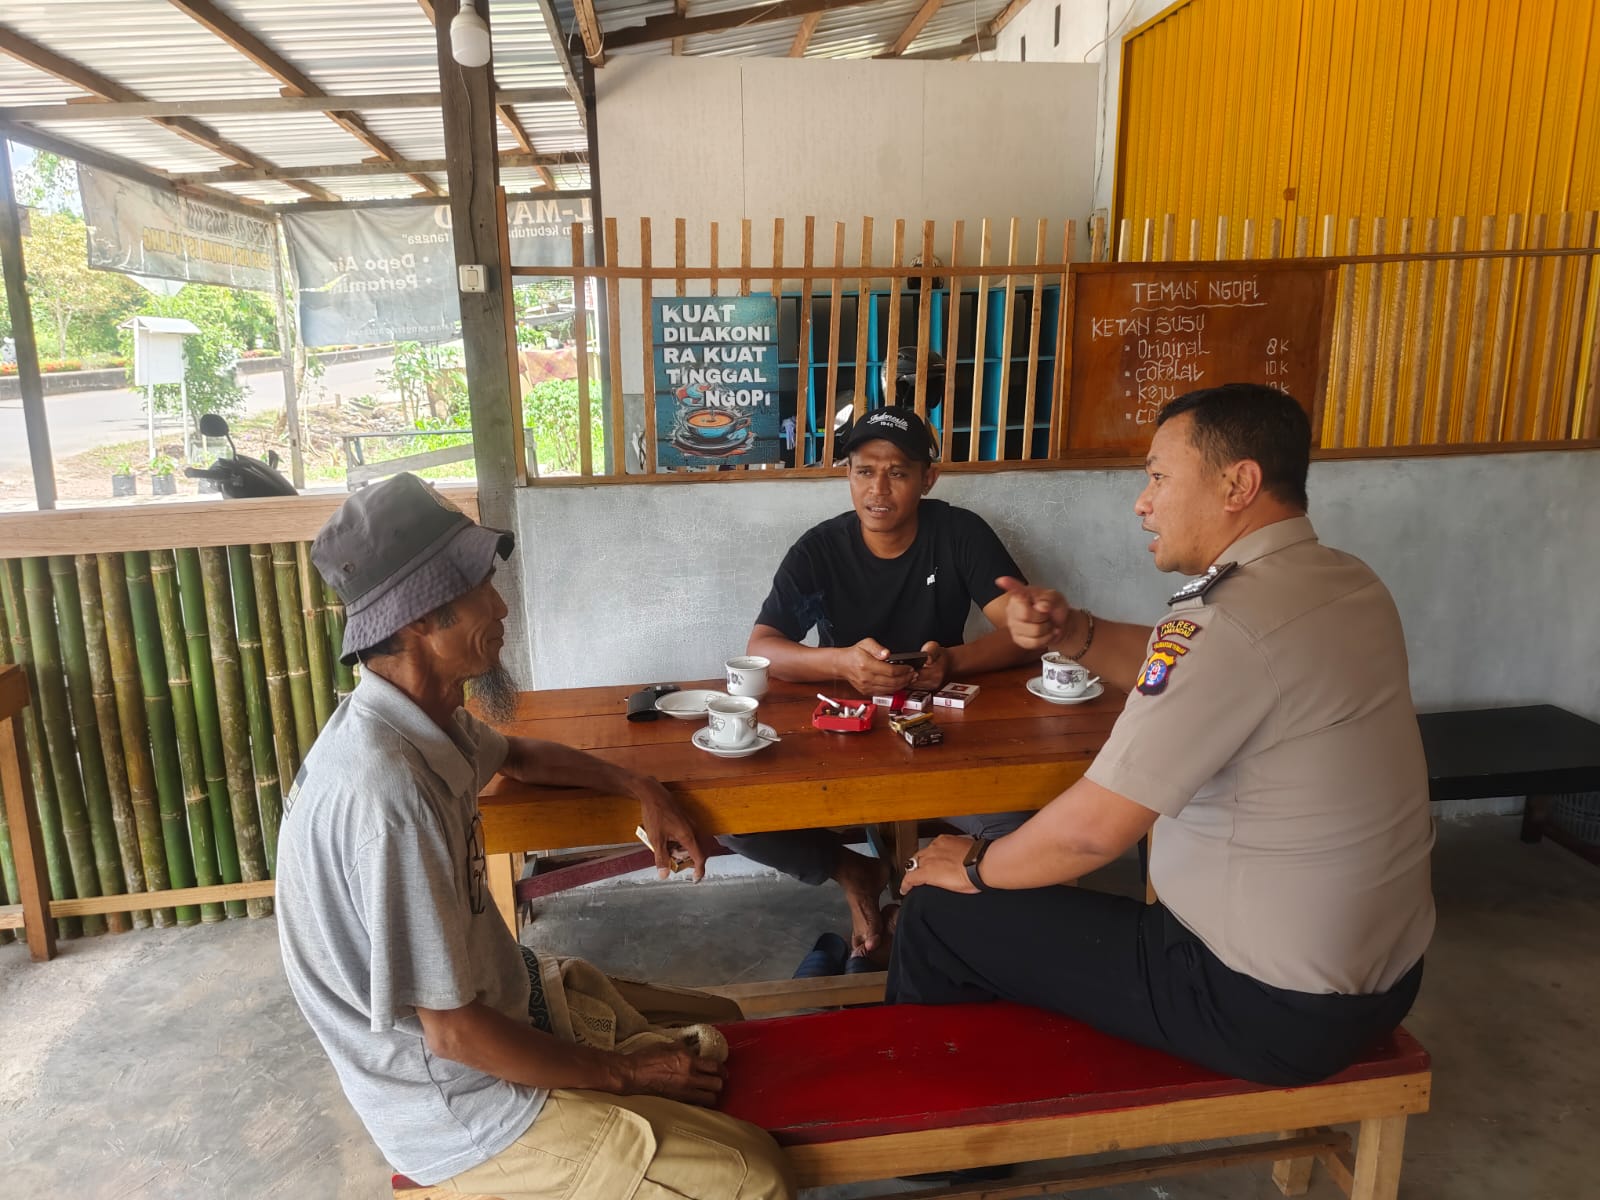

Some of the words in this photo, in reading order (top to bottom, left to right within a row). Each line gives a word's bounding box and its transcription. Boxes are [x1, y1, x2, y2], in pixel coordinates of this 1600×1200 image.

[1132, 280, 1198, 303] TEMAN
[662, 304, 736, 323] KUAT
[663, 326, 770, 343] DILAKONI
[1091, 316, 1150, 342] KETAN
[1154, 313, 1206, 336] SUSU
[663, 347, 697, 363] RA
[704, 346, 767, 363] KUAT
[666, 368, 767, 385] TINGGAL
[1160, 620, 1197, 635] POLRES
